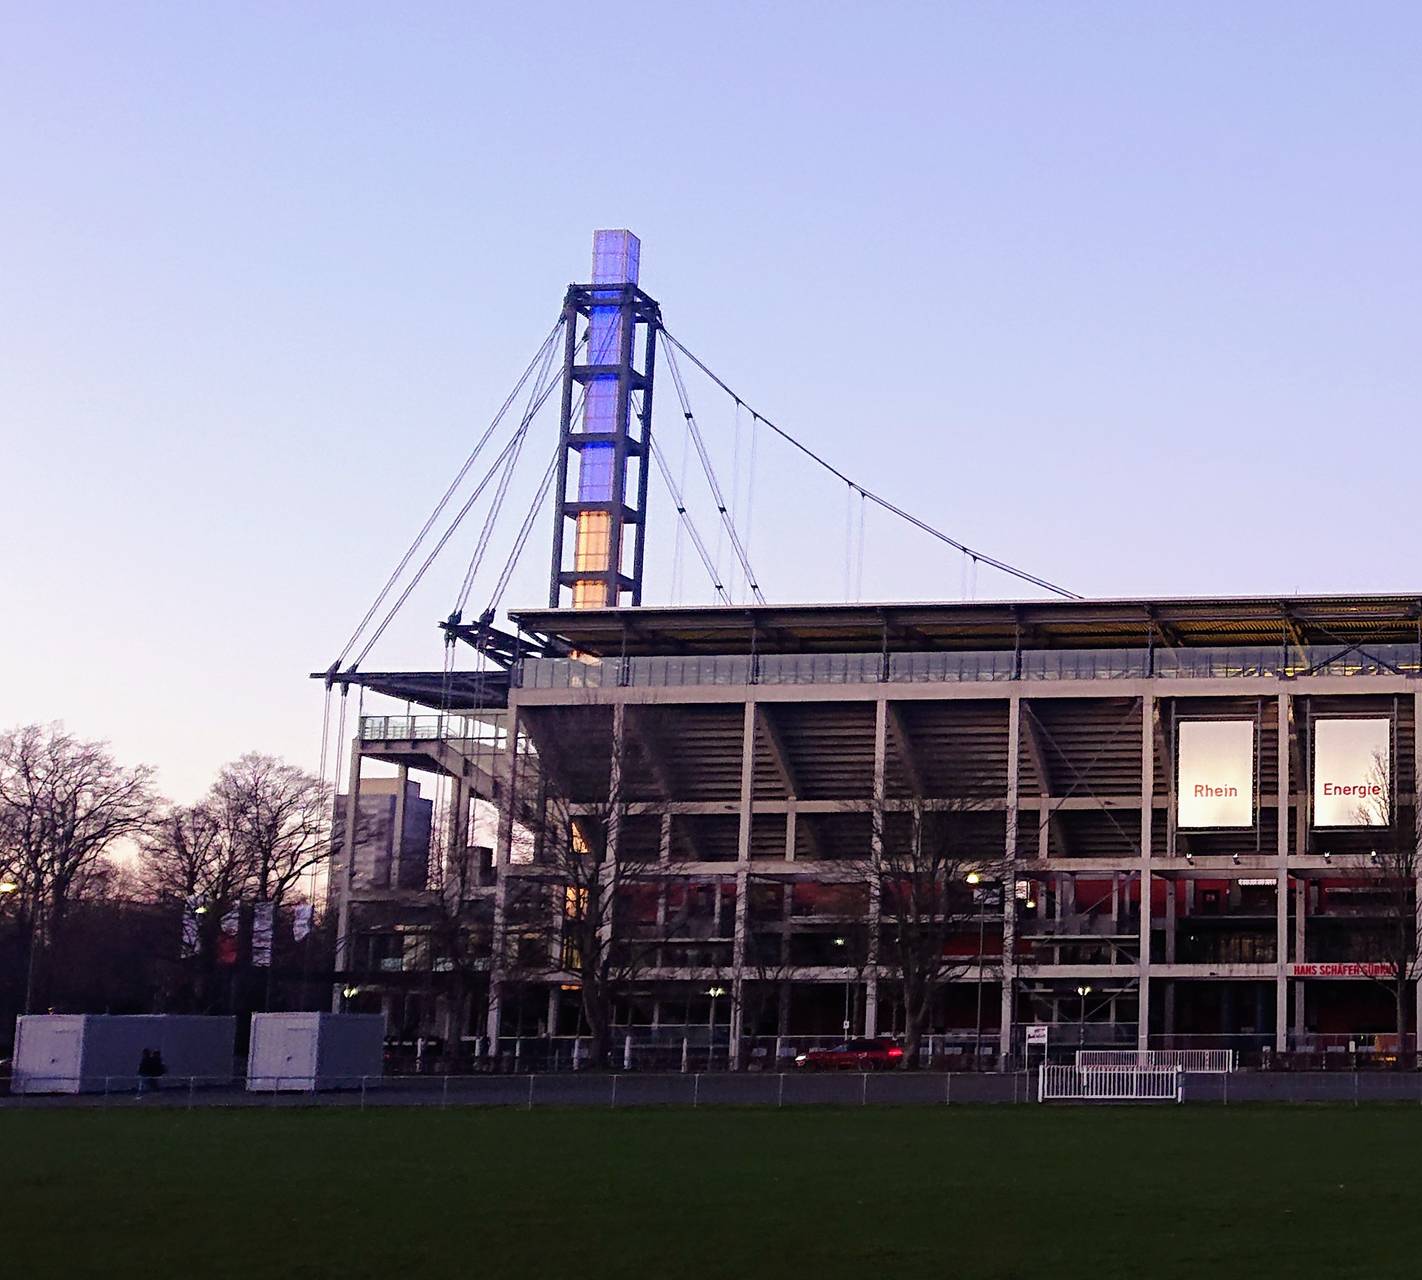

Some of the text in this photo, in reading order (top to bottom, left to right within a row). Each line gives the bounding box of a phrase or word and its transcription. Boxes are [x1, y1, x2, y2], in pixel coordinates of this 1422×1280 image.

[1194, 784, 1238, 798] Rhein
[1323, 783, 1382, 798] Energie
[1293, 965, 1317, 976] HANS
